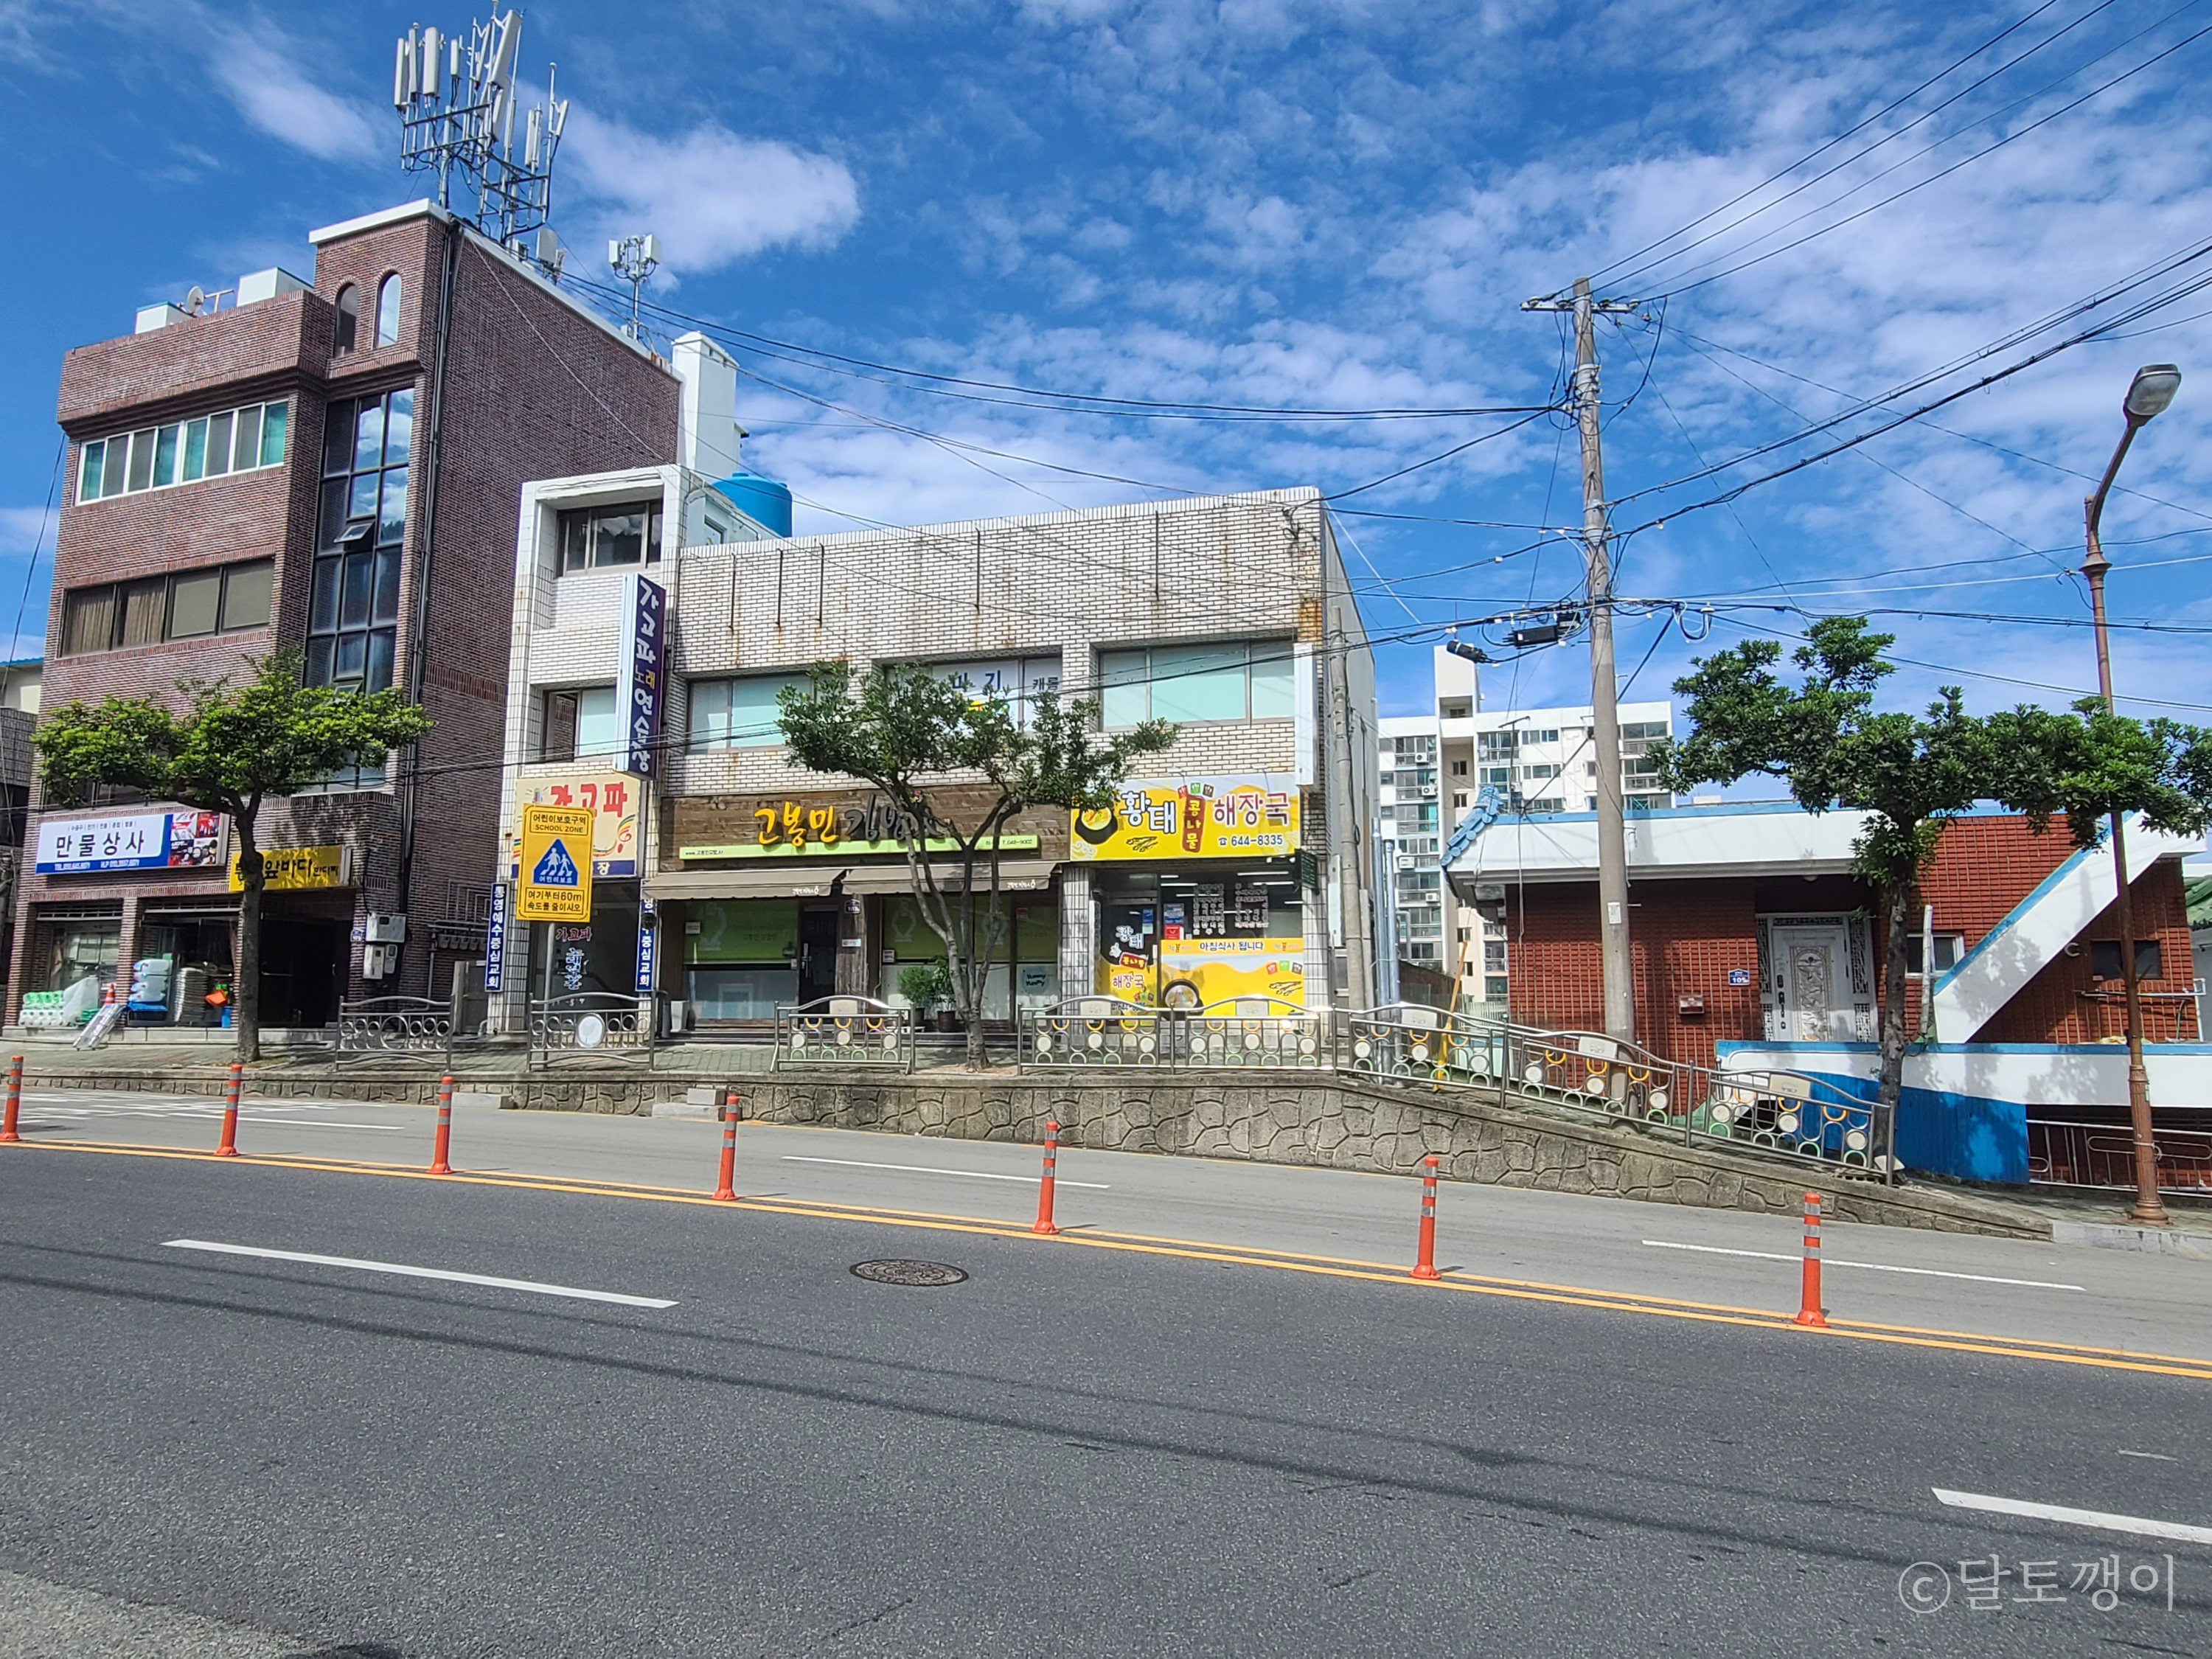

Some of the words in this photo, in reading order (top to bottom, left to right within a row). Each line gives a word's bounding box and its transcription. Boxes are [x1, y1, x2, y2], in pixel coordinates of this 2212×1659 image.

[636, 580, 659, 664] 가고파
[533, 813, 586, 825] 어린이보호구역
[1119, 790, 1176, 835] 황태
[1186, 799, 1202, 849] 콩나물
[1214, 793, 1290, 827] 해장국
[535, 824, 563, 833] SCHOOL
[56, 830, 145, 858] 만물상사
[1231, 835, 1283, 846] 644-8335
[539, 875, 573, 884] 어린이보호
[527, 902, 550, 911] 속도를
[552, 902, 581, 912] 줄이시오
[487, 886, 505, 989] 통영예수중심교회
[555, 926, 592, 942] 가고파
[1115, 925, 1144, 950] 황태
[1199, 942, 1235, 950] 아침식사
[1238, 941, 1264, 950] 됩니다
[1112, 973, 1144, 990] 해장국
